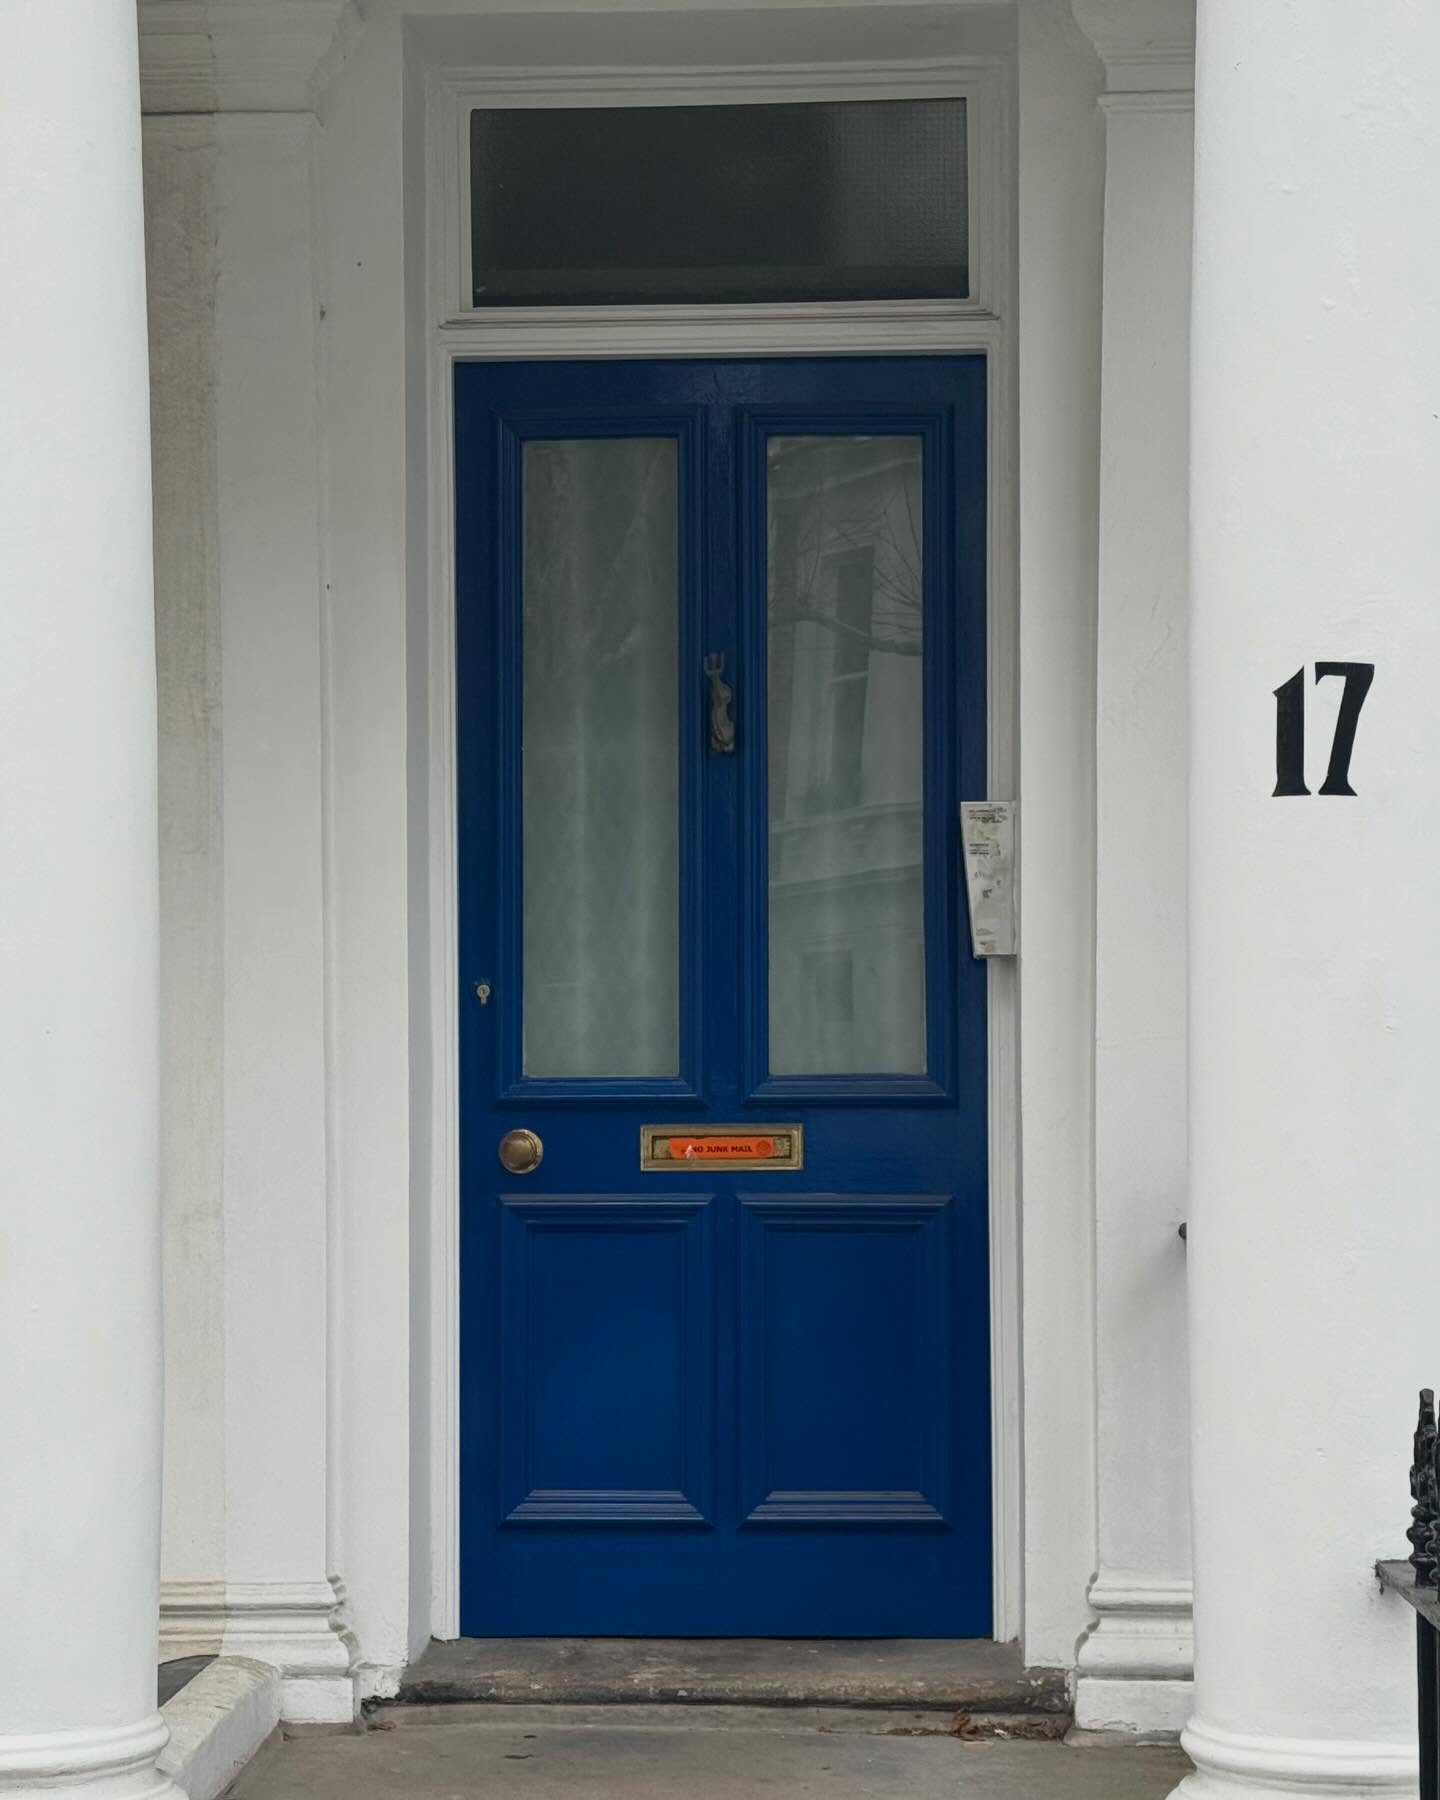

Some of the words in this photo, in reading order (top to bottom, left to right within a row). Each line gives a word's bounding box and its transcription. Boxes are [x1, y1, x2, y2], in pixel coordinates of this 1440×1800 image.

[1272, 662, 1375, 797] 17
[706, 1145, 728, 1153] JUNK
[730, 1145, 753, 1153] MAIL
